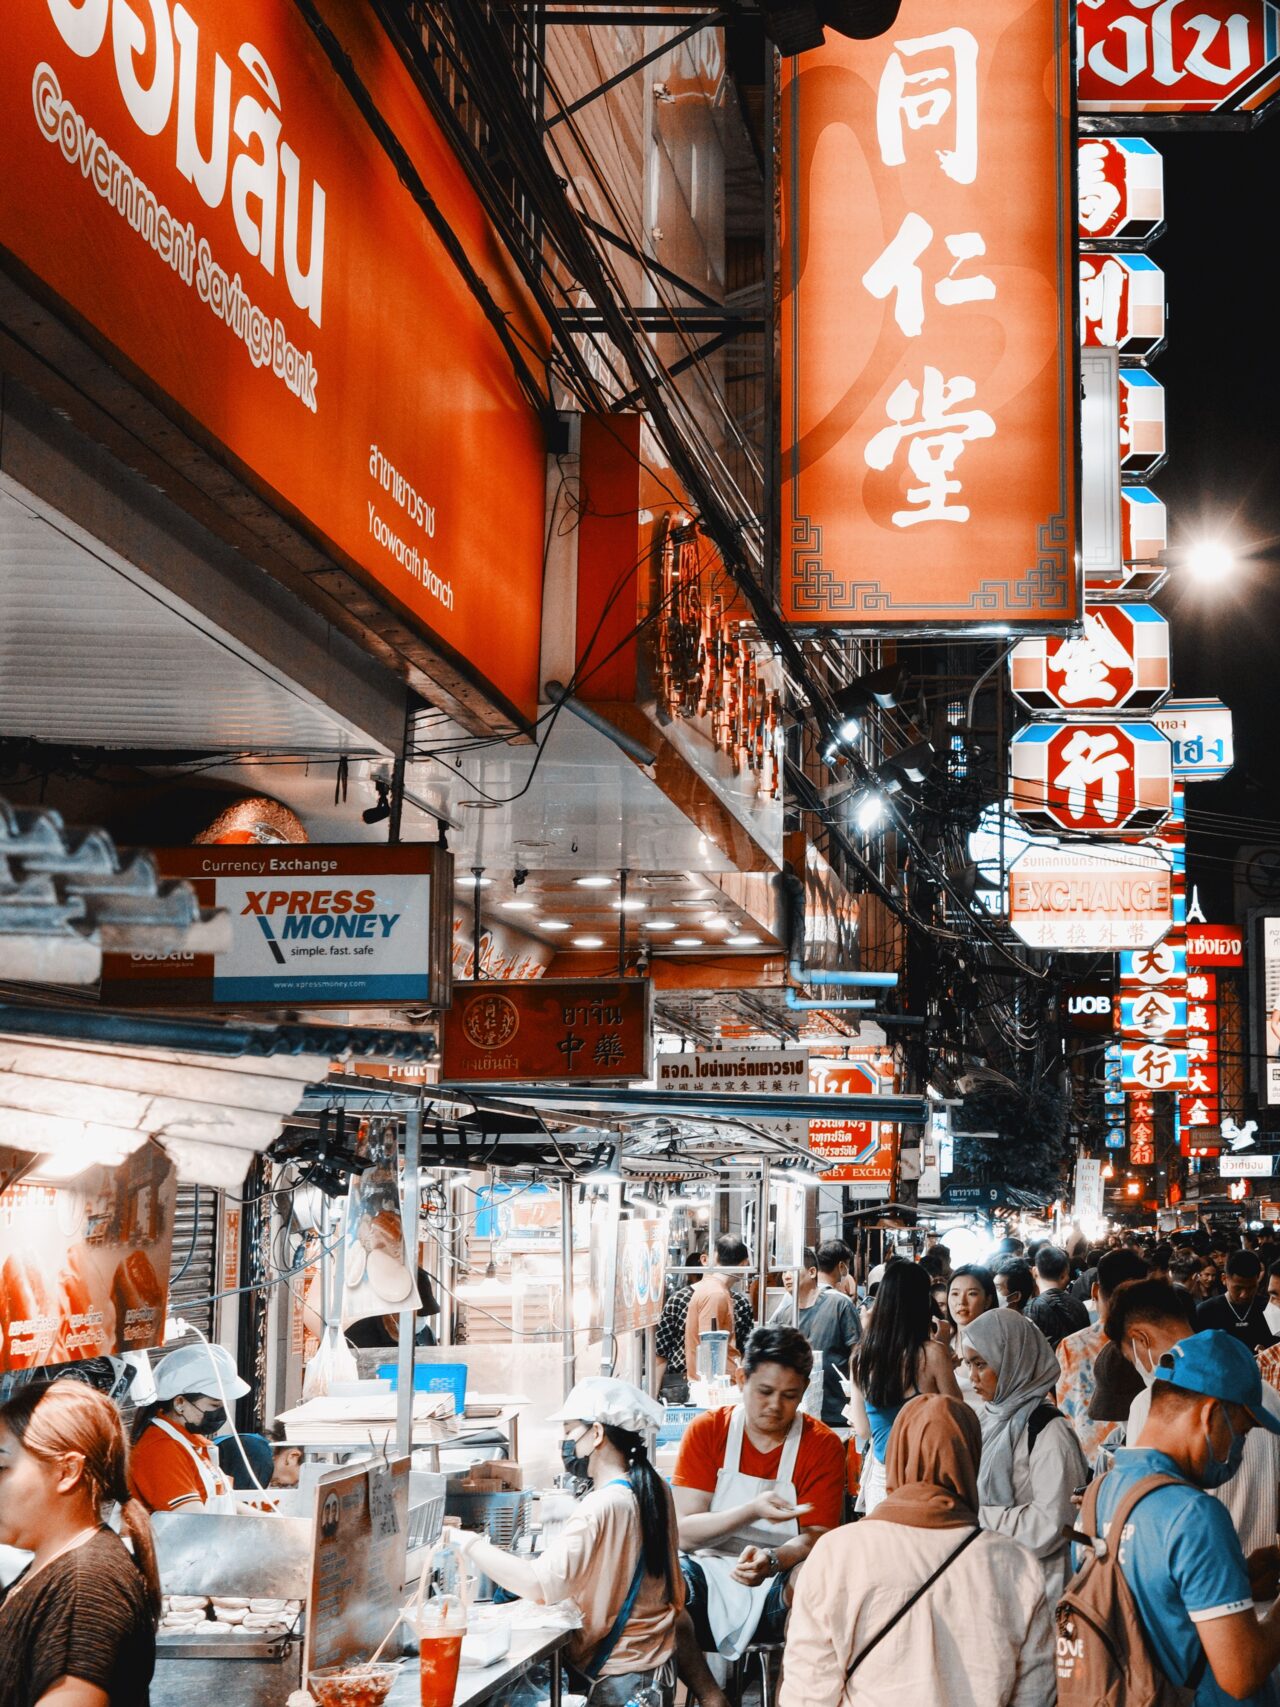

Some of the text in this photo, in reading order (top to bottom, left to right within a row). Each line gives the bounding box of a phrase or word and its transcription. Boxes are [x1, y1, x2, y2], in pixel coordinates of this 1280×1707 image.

[32, 62, 317, 413] Government Savings Bank
[862, 27, 996, 528] 同仁堂
[369, 444, 435, 538] สาขาเยาวราช
[368, 500, 453, 611] Yaowarath Branch
[202, 859, 338, 874] Currency Exchange
[240, 889, 377, 915] XPRESS
[1014, 880, 1169, 911] EXCHANGE
[282, 913, 400, 940] MONEY
[291, 945, 374, 957] simple. fast. safe
[274, 980, 367, 989] www.xpressmoney.com
[1068, 996, 1112, 1015] UOB
[388, 1064, 426, 1077] Fruit
[814, 1168, 846, 1177] ONEY
[990, 1189, 998, 1201] 9
[1056, 1637, 1084, 1658] OVE
